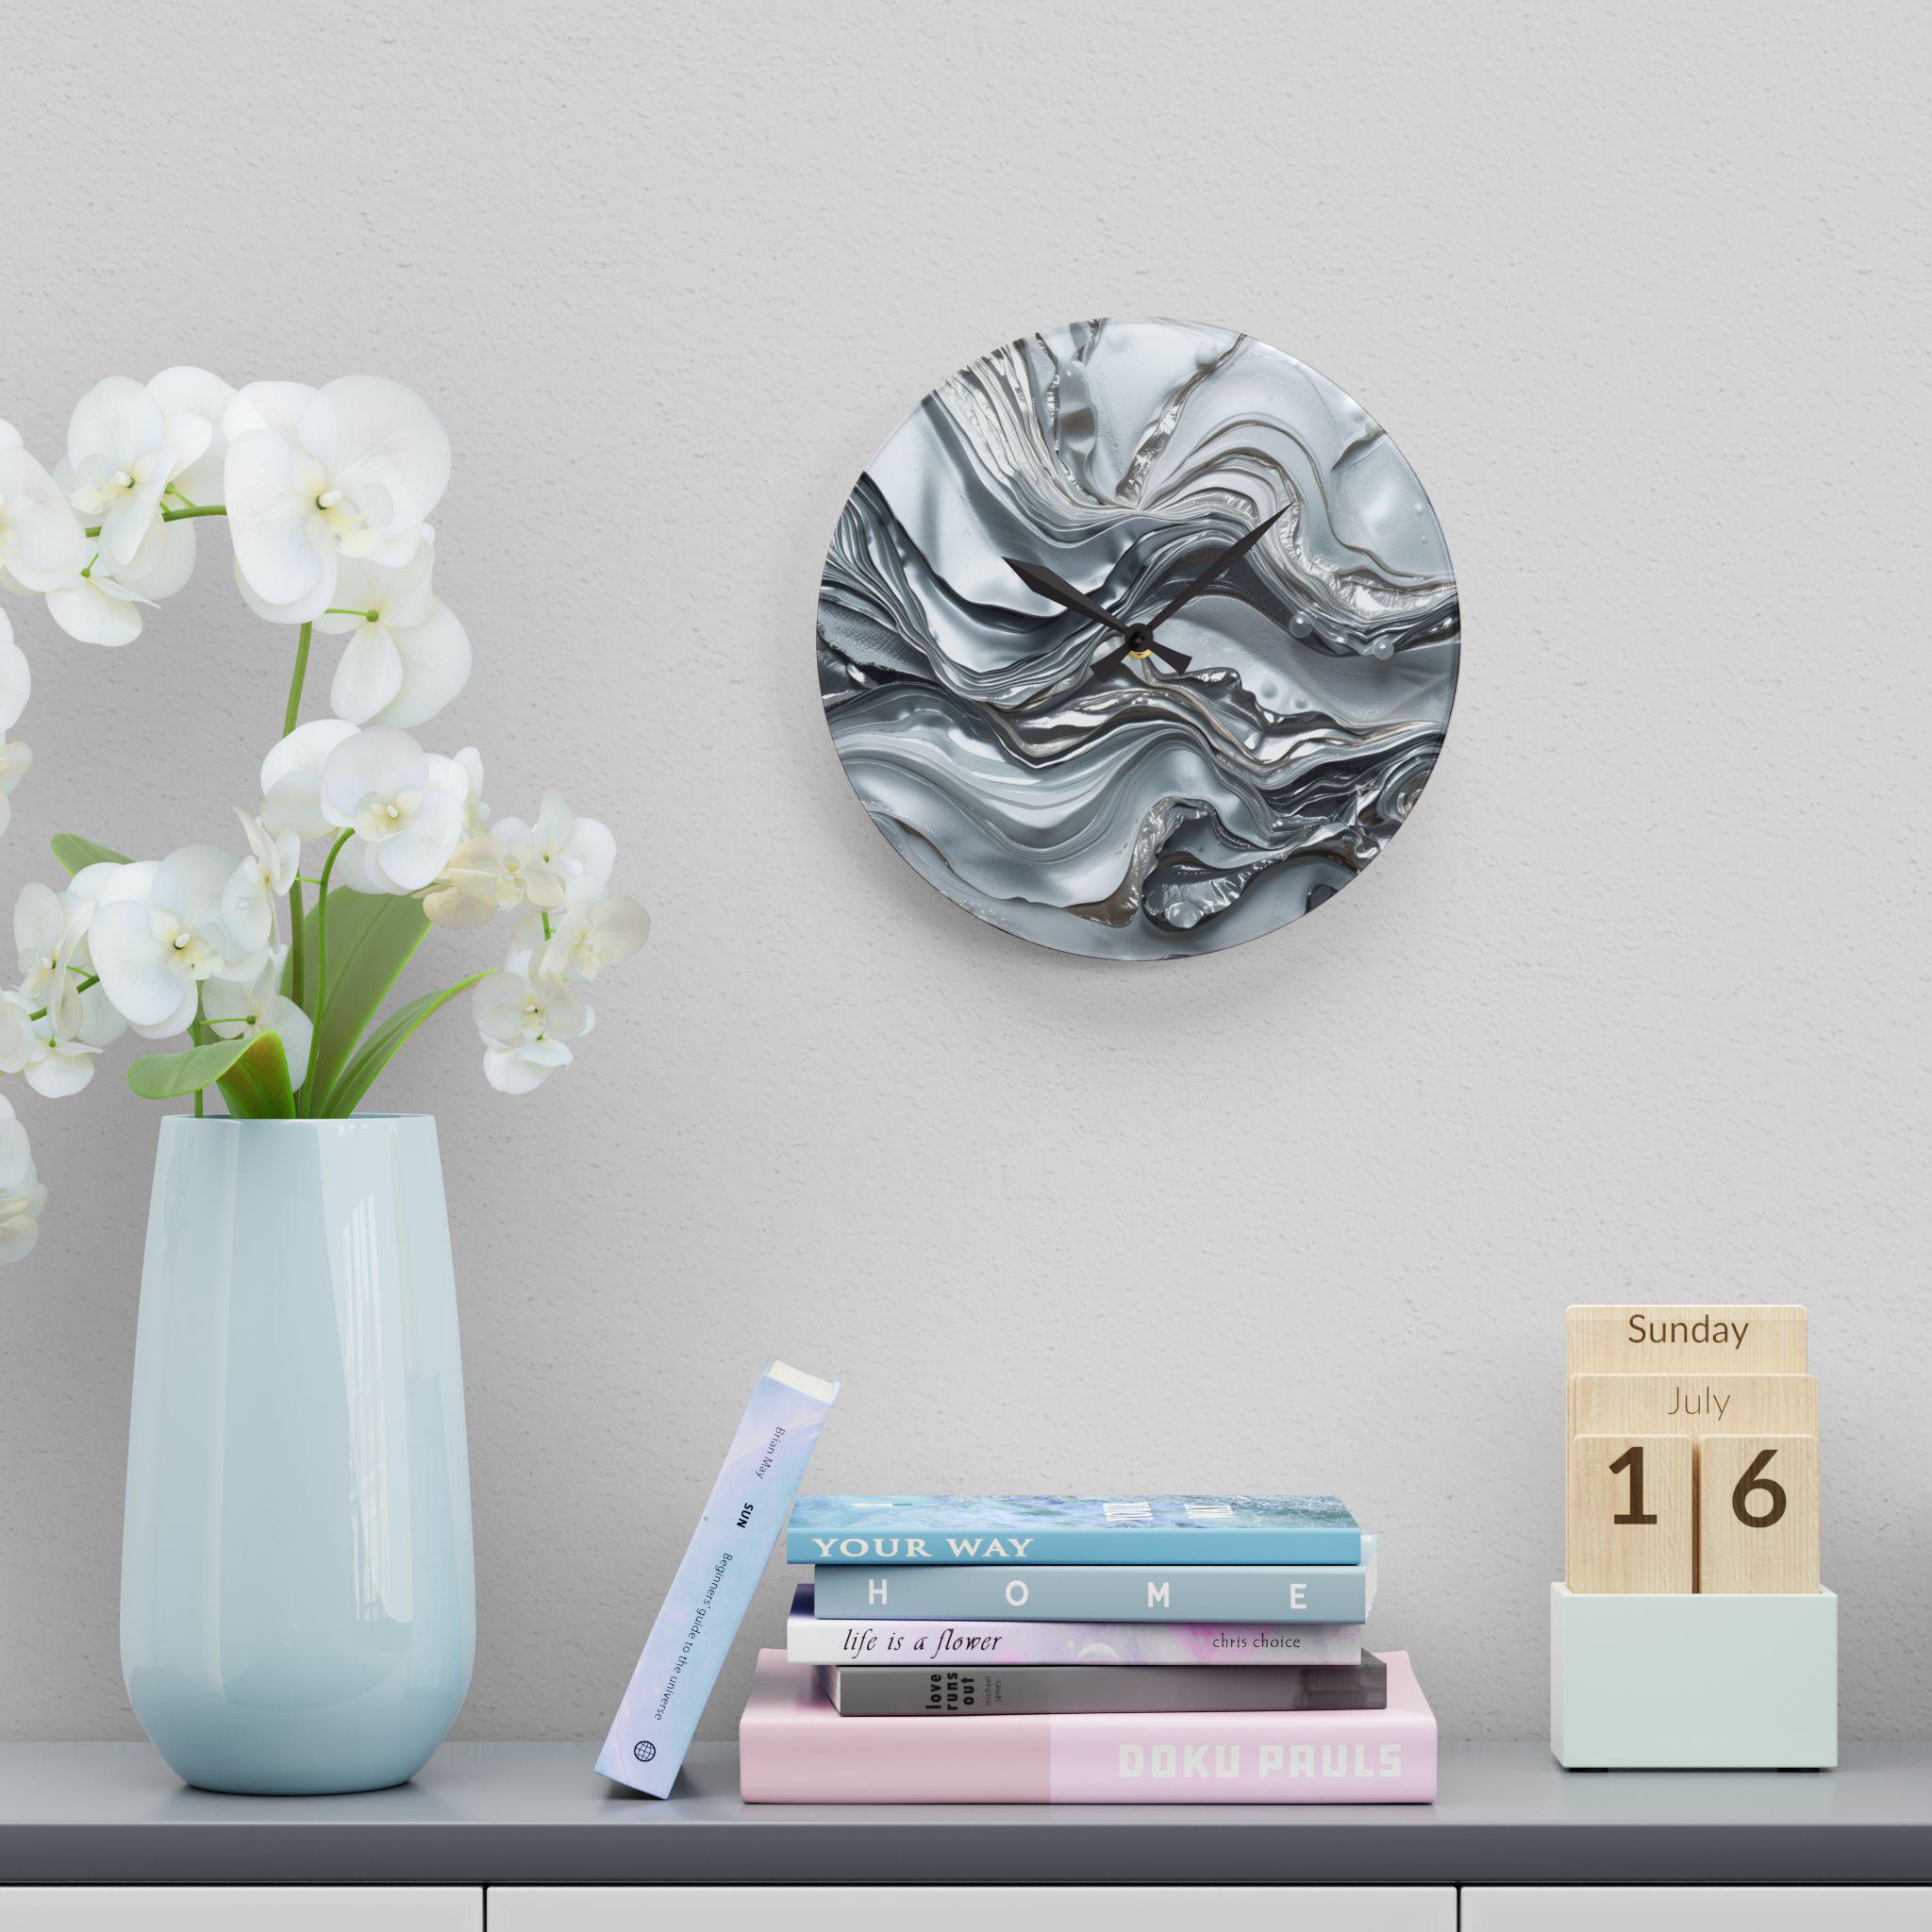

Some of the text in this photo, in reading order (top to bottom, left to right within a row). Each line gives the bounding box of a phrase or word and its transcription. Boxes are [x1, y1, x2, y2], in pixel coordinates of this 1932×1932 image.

[1627, 1313, 1749, 1350] Sunday
[1666, 1386, 1732, 1422] July
[755, 1426, 785, 1480] Brian May
[736, 1502, 754, 1529] SUN
[811, 1538, 1035, 1557] YOUR WAY
[688, 1607, 707, 1640] guide
[682, 1641, 693, 1654] to
[843, 1628, 1003, 1659] life is a flower
[1212, 1632, 1301, 1648] chris choice
[673, 1656, 688, 1674] the
[654, 1676, 678, 1721] universe
[925, 1674, 942, 1709] love
[946, 1672, 958, 1711] runs
[960, 1676, 975, 1706] out
[984, 1675, 993, 1707] michael
[994, 1679, 1004, 1703] james
[1118, 1743, 1403, 1778] DOKU PAULS
